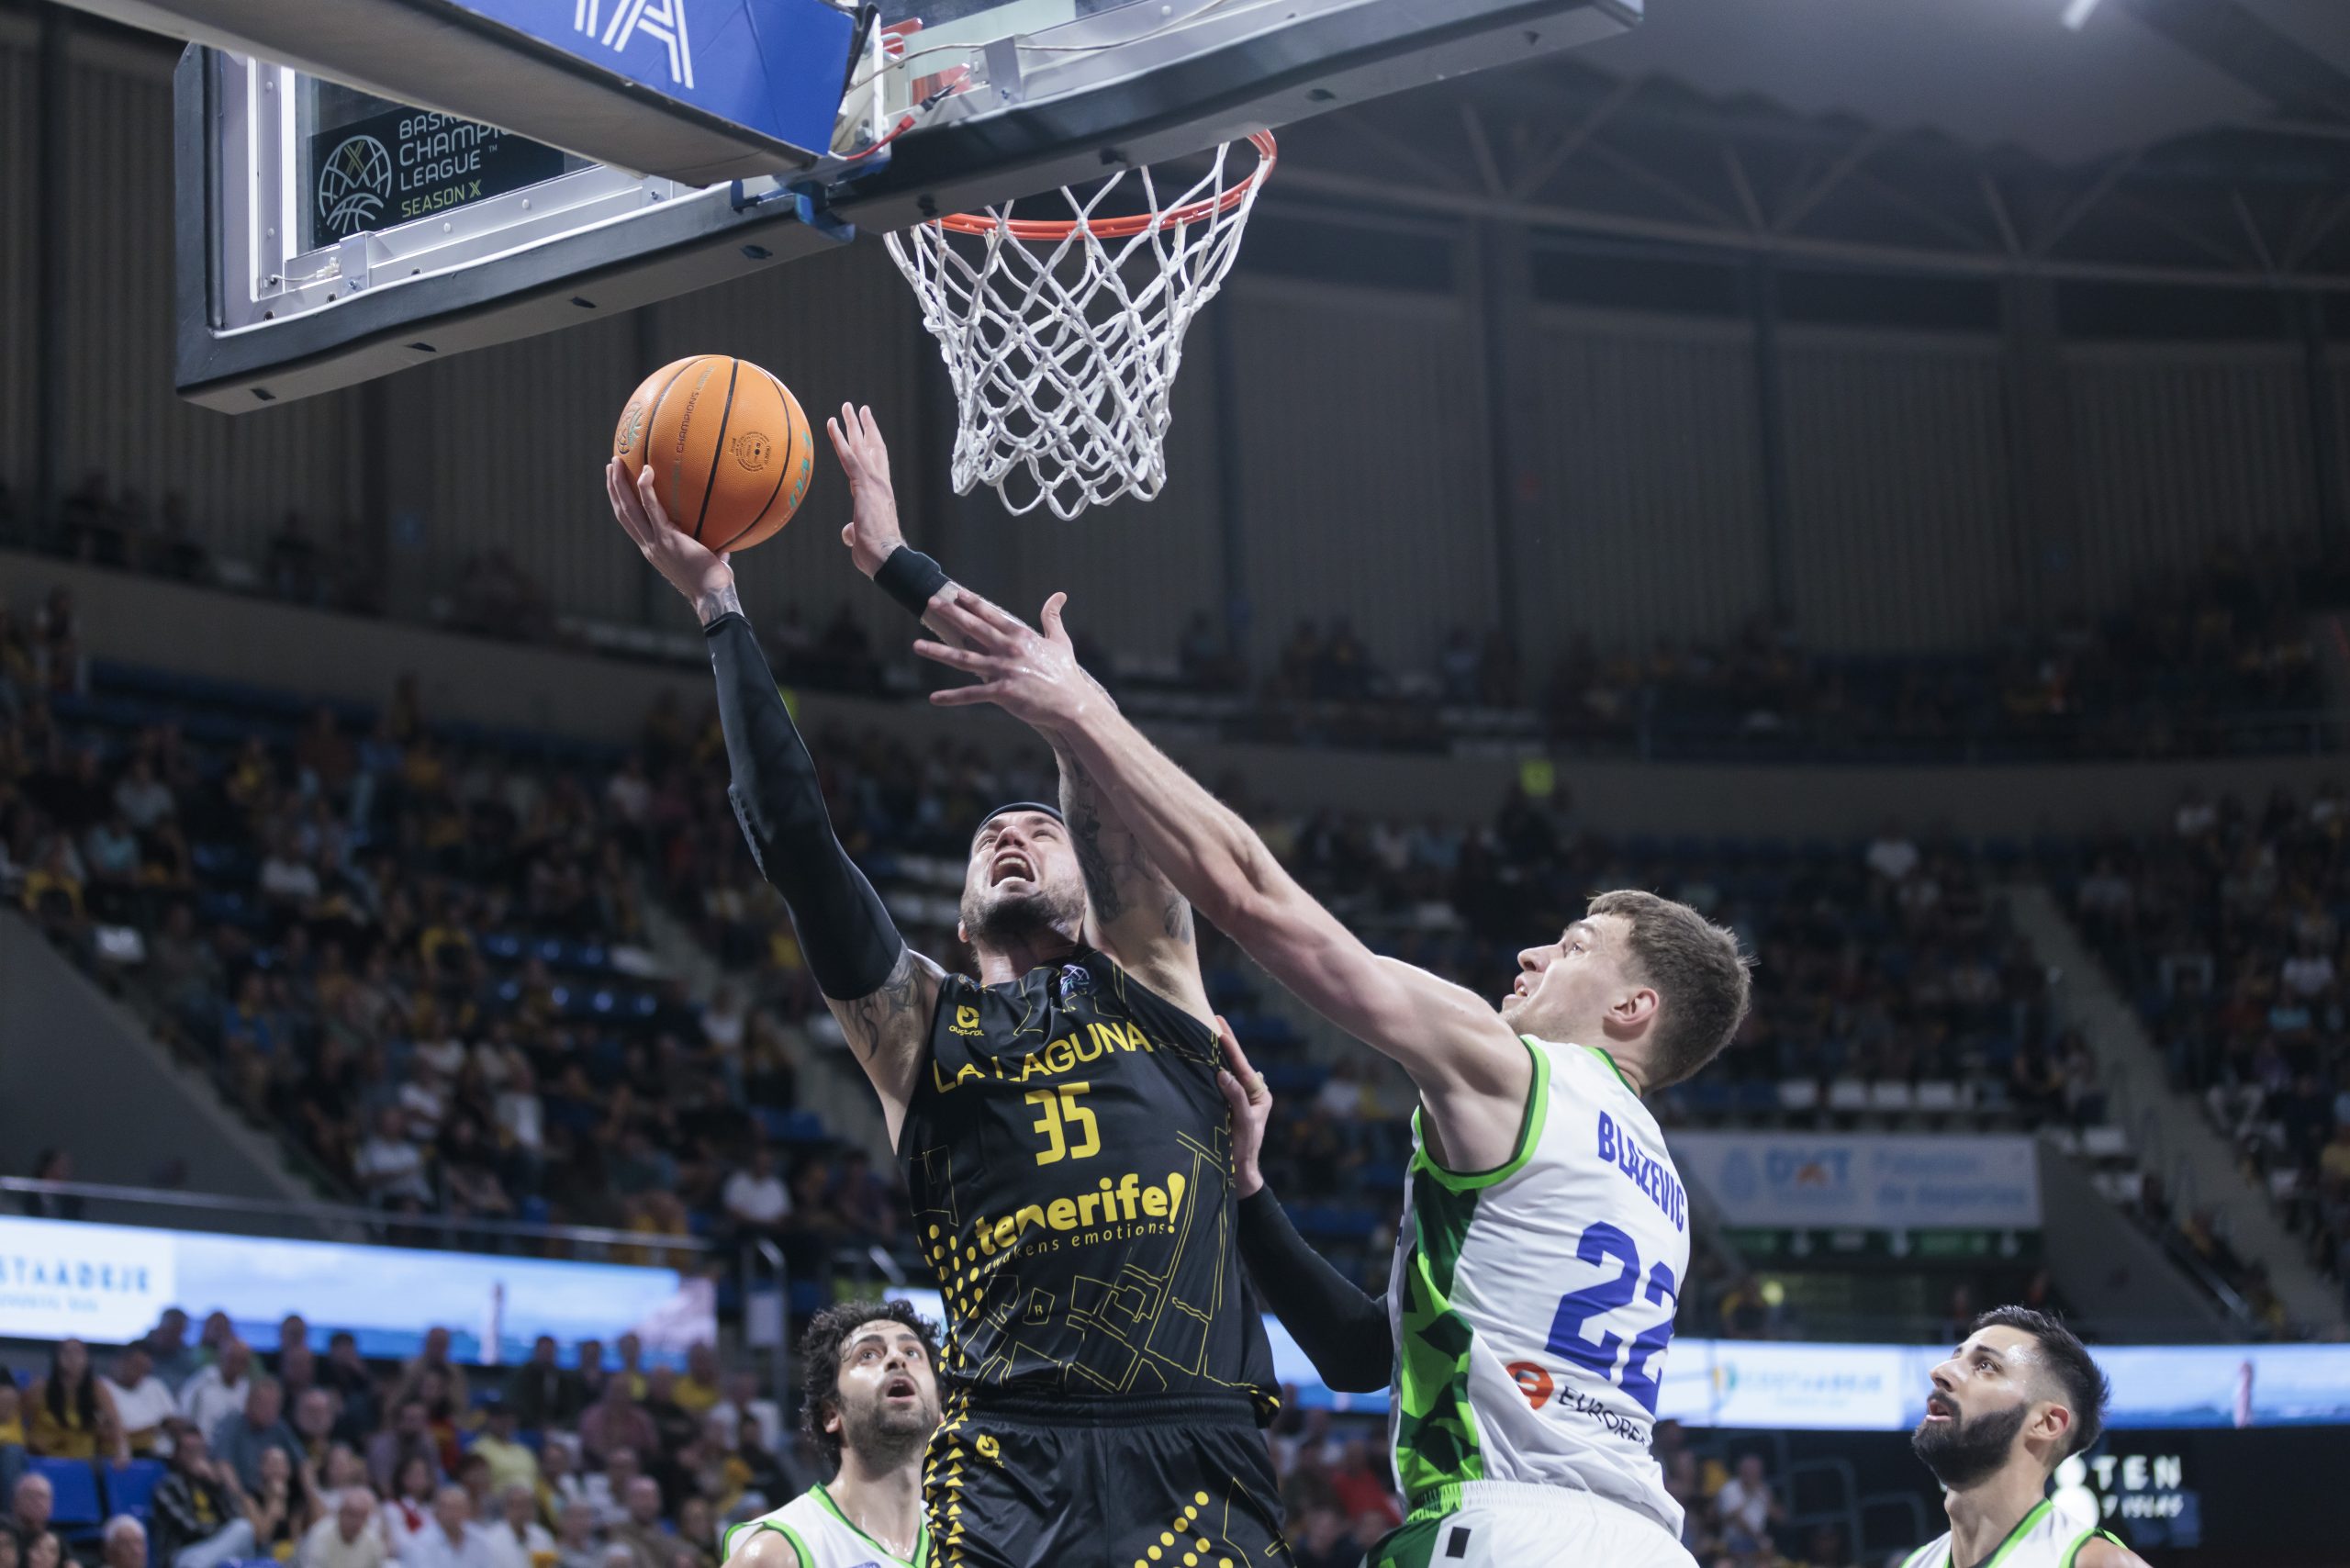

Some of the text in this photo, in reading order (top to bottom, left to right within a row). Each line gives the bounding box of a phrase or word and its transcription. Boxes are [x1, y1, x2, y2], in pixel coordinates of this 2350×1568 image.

[400, 150, 481, 191] LEAGUE
[401, 179, 482, 218] SEASON X
[677, 391, 699, 454] CHAMPIONS
[934, 1022, 1154, 1093] LA LAGUNA
[1024, 1081, 1102, 1167] 35
[1598, 1110, 1684, 1233] BLAZEVIC
[984, 1238, 1059, 1273] awakens
[1545, 1220, 1679, 1423] 22
